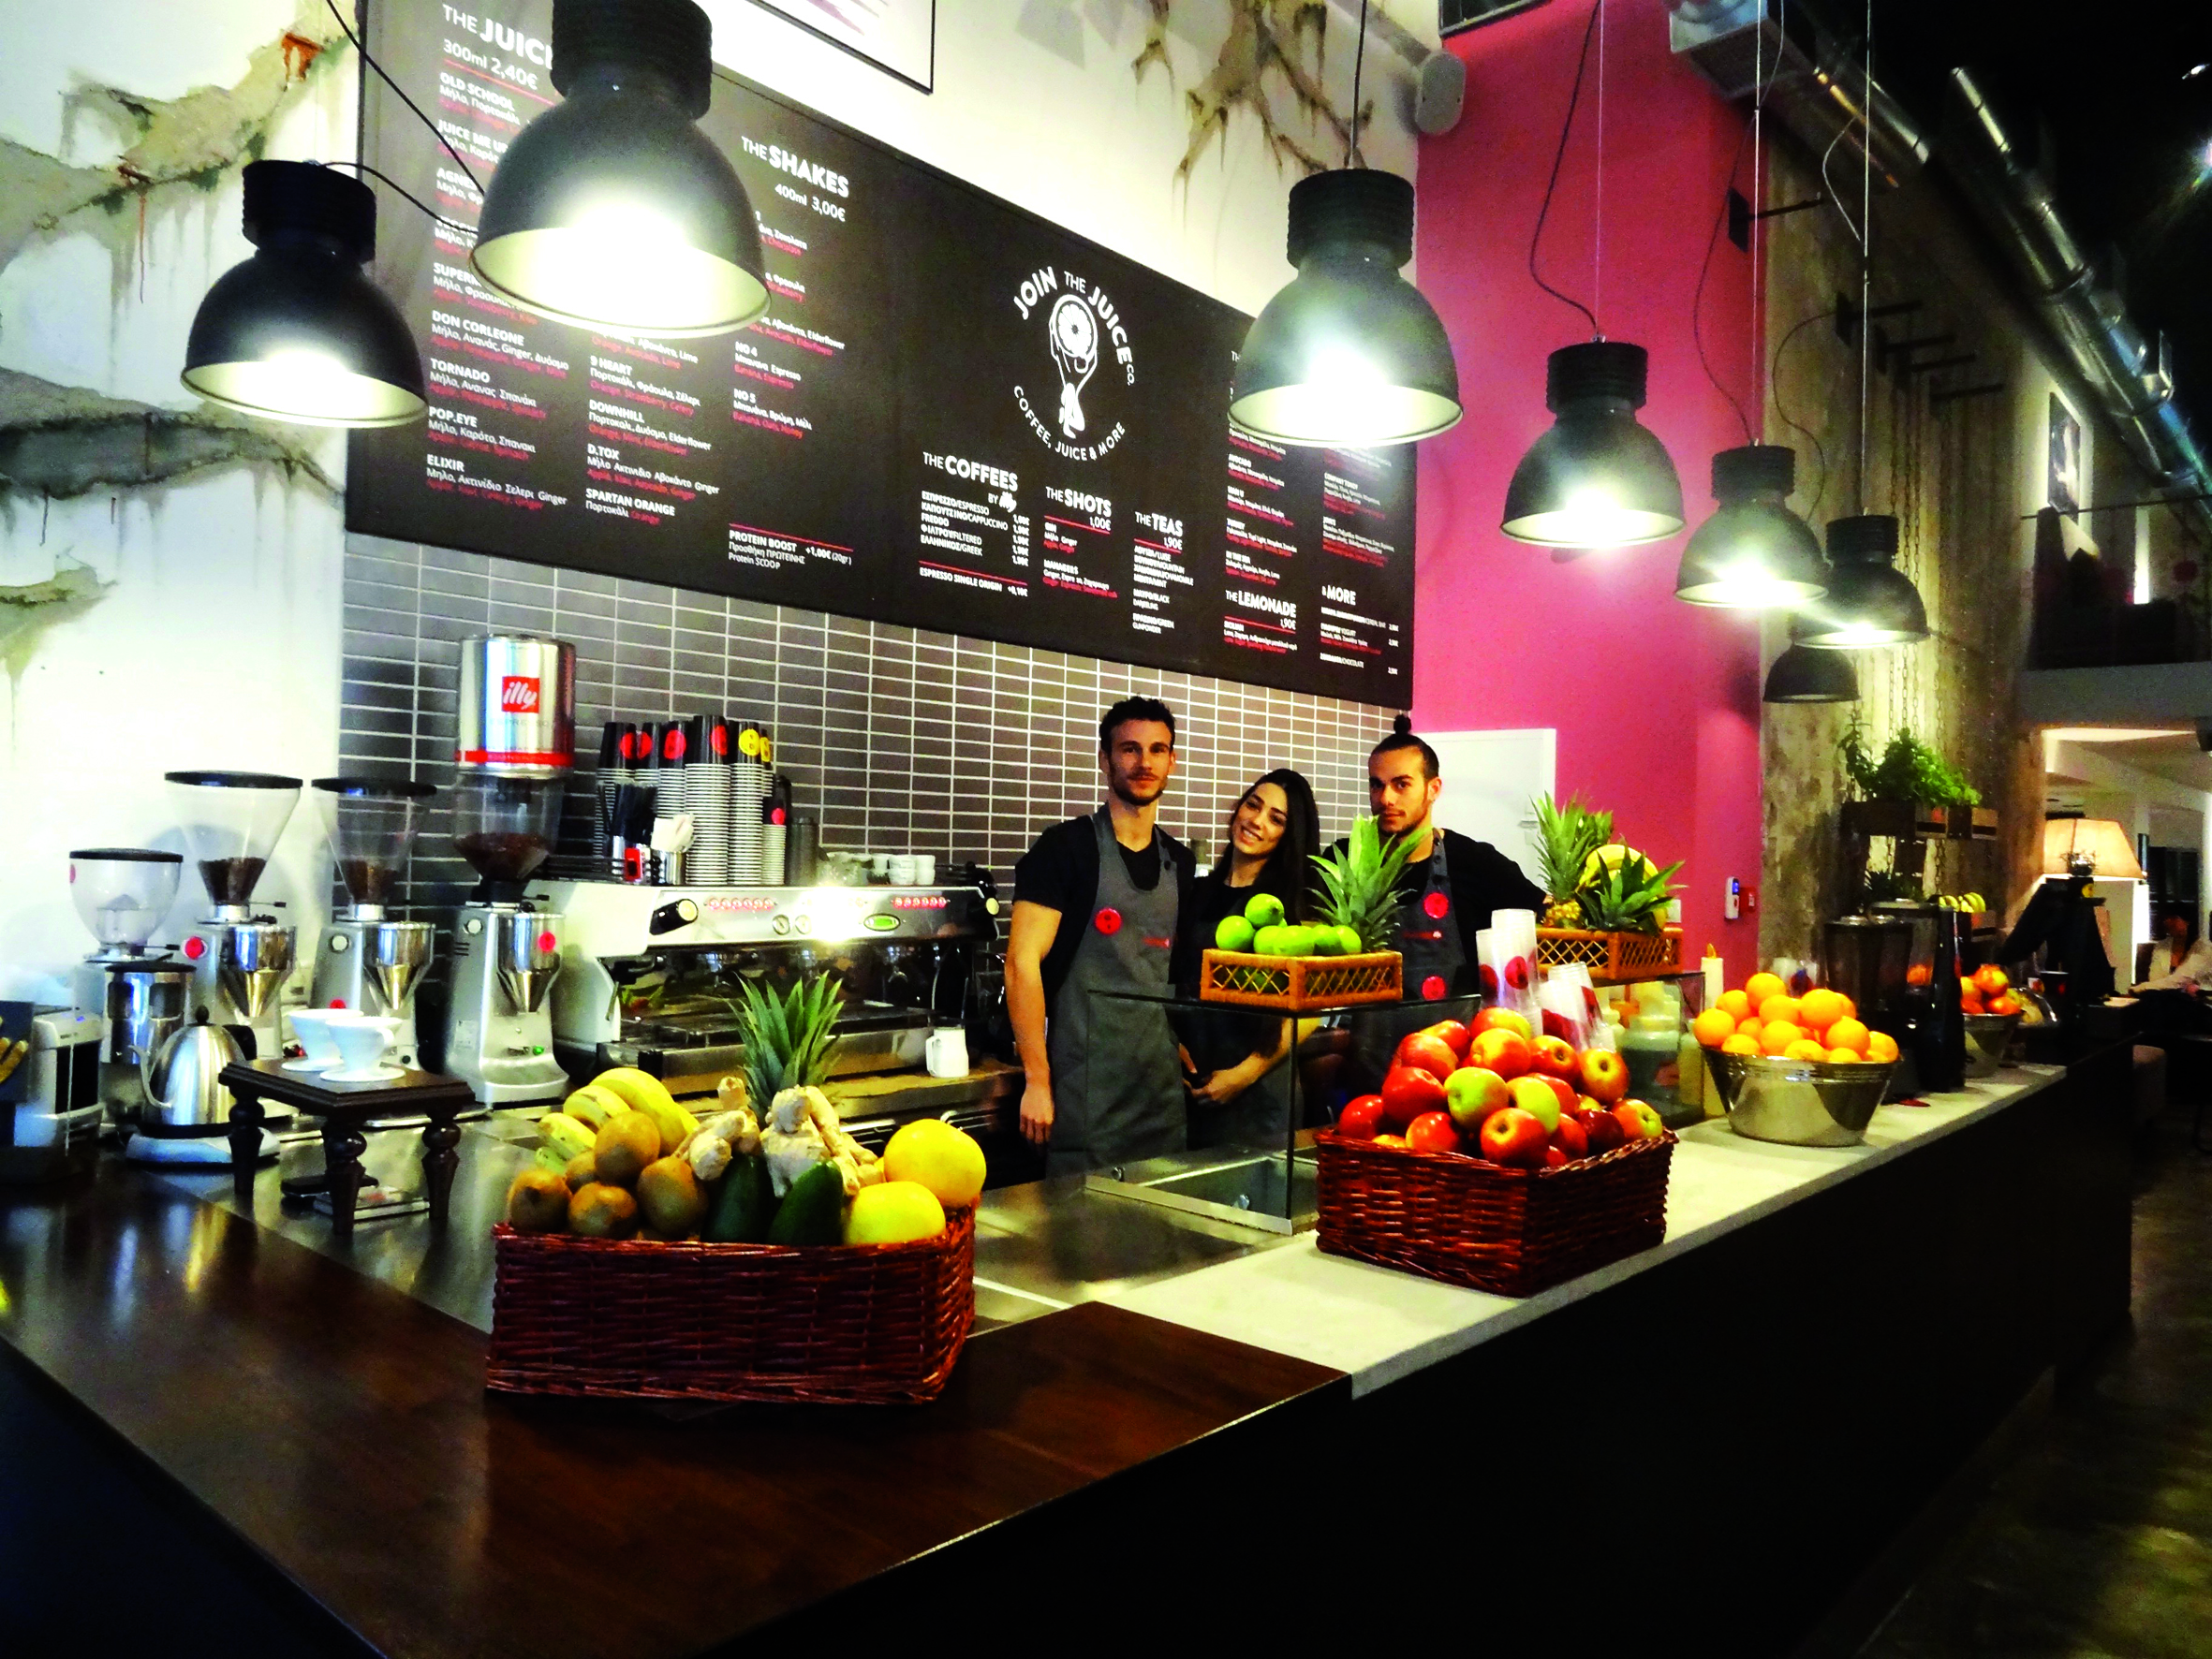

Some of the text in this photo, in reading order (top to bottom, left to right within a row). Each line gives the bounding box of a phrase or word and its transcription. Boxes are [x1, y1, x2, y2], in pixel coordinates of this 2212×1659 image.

[443, 4, 479, 35] THE
[443, 38, 539, 91] 300ml 2,40€
[439, 72, 516, 112] OLD SCHOOL
[437, 120, 471, 141] JUICE
[472, 132, 493, 148] ME
[741, 135, 849, 198] THE SHAKES
[774, 184, 847, 223] 400ml 3,00€
[432, 310, 461, 328] DON
[463, 320, 525, 346] CORLEONE
[1013, 266, 1058, 320] JOIN
[1063, 270, 1086, 294] THE
[1087, 286, 1134, 365] JUICE
[735, 341, 759, 357] NO 4
[430, 358, 491, 384] TORNADO
[599, 357, 634, 376] HEART
[733, 388, 749, 402] NO
[428, 406, 479, 428] POP.EYE
[589, 399, 646, 425] DOWNHILL
[1013, 385, 1053, 449] COFFEE,
[1054, 440, 1088, 462] JUICE
[1098, 421, 1126, 457] MORE
[426, 454, 465, 473] ELIXIR
[587, 443, 621, 461] D.TOX
[922, 451, 1018, 492] THE COFFEES
[537, 491, 568, 507] Ginger
[585, 488, 676, 518] SPARTAN ORANGE
[988, 492, 999, 505] BY
[1045, 486, 1112, 518] THE SHOTS
[1089, 516, 1112, 532] 1,00€
[1134, 510, 1184, 537] THE TEAS
[729, 529, 767, 547] PROTEIN
[767, 537, 798, 553] BOOST
[754, 557, 781, 570] SCOOP
[919, 566, 953, 582] ESPRESSO
[953, 574, 979, 588] SINGLE
[978, 579, 1003, 593] ORIGIN
[1225, 589, 1238, 603] THE
[1238, 590, 1297, 619] LEMONADE
[1326, 584, 1356, 606] MORE
[503, 681, 538, 710] illy
